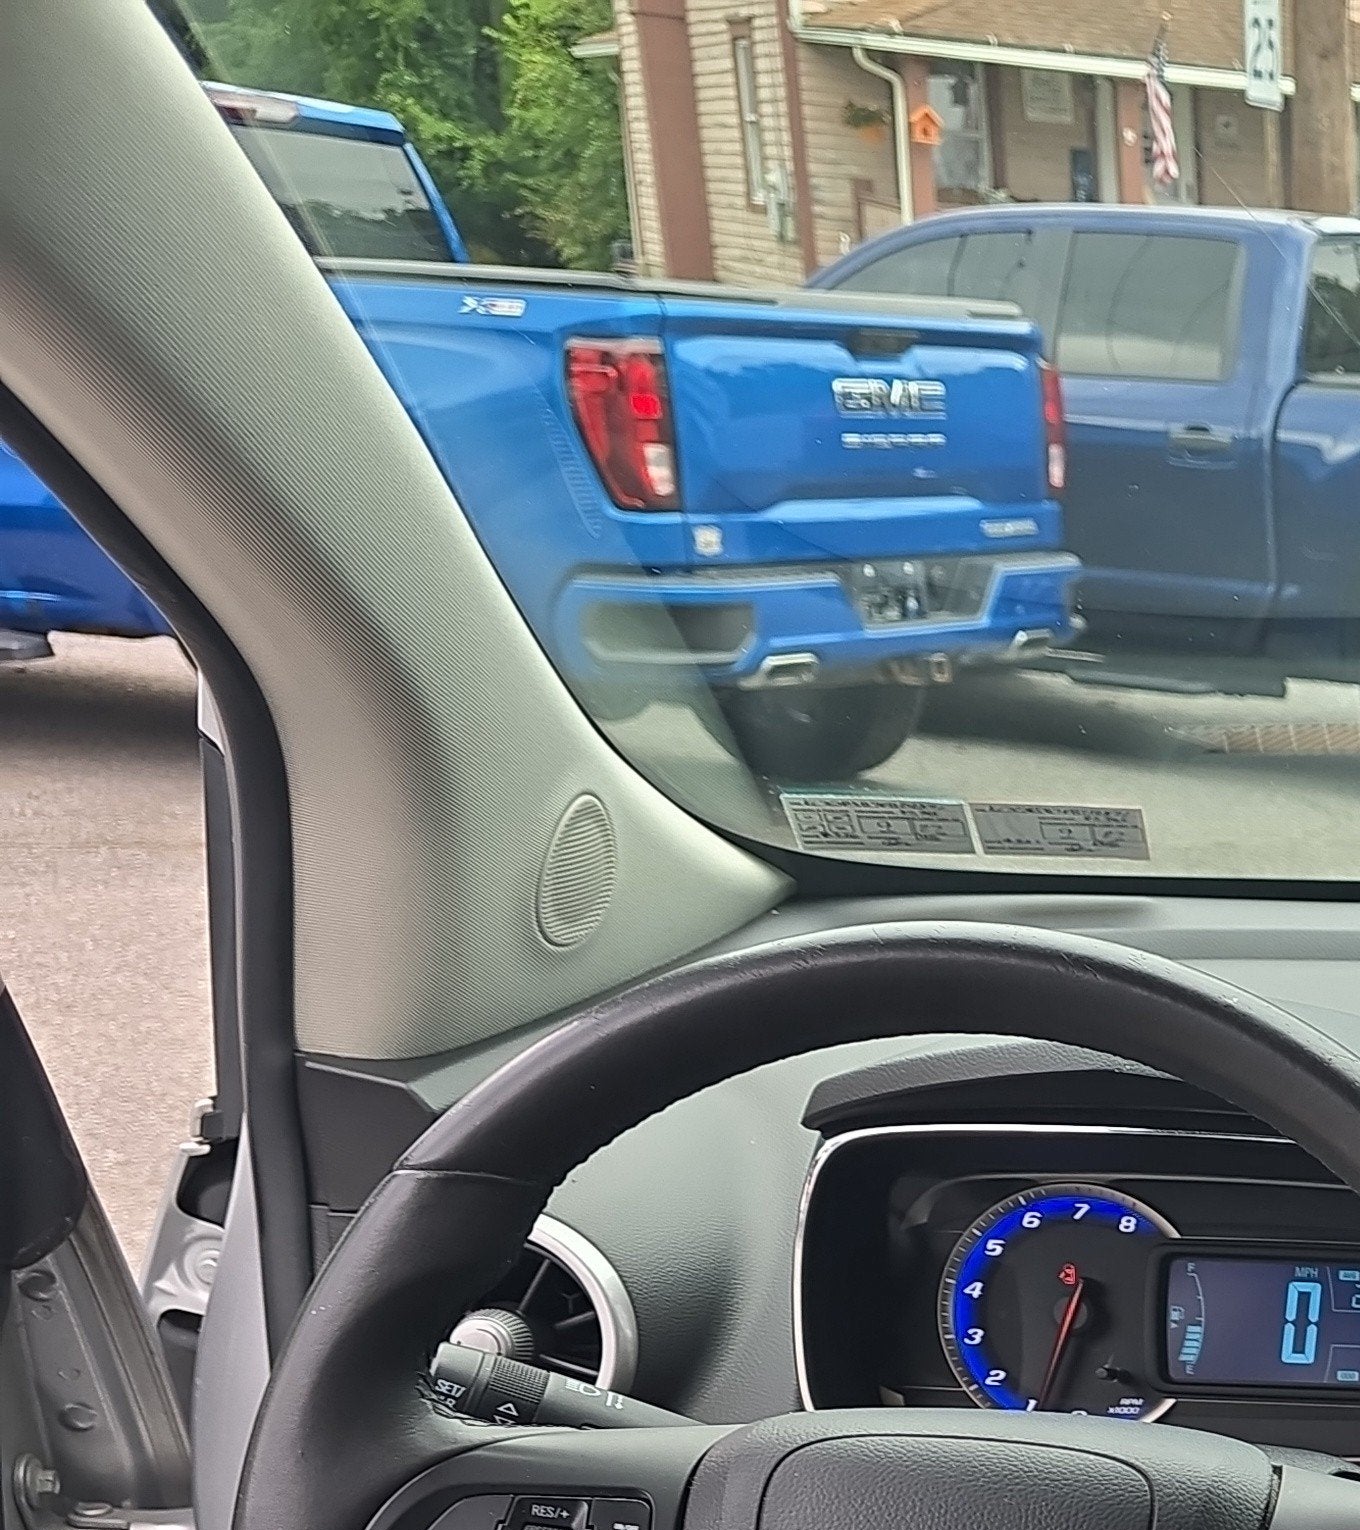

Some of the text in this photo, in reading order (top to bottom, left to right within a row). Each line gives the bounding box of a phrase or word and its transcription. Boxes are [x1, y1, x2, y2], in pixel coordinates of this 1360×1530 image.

[1248, 17, 1275, 81] 25
[1022, 1212, 1043, 1228] 6
[1073, 1203, 1091, 1220] 7
[1118, 1216, 1137, 1233] 8
[984, 1239, 1006, 1256] 5
[1294, 1266, 1318, 1279] MPH
[963, 1282, 984, 1299] 4
[1281, 1281, 1321, 1364] 0
[963, 1328, 985, 1345] 3
[984, 1370, 1007, 1386] 2
